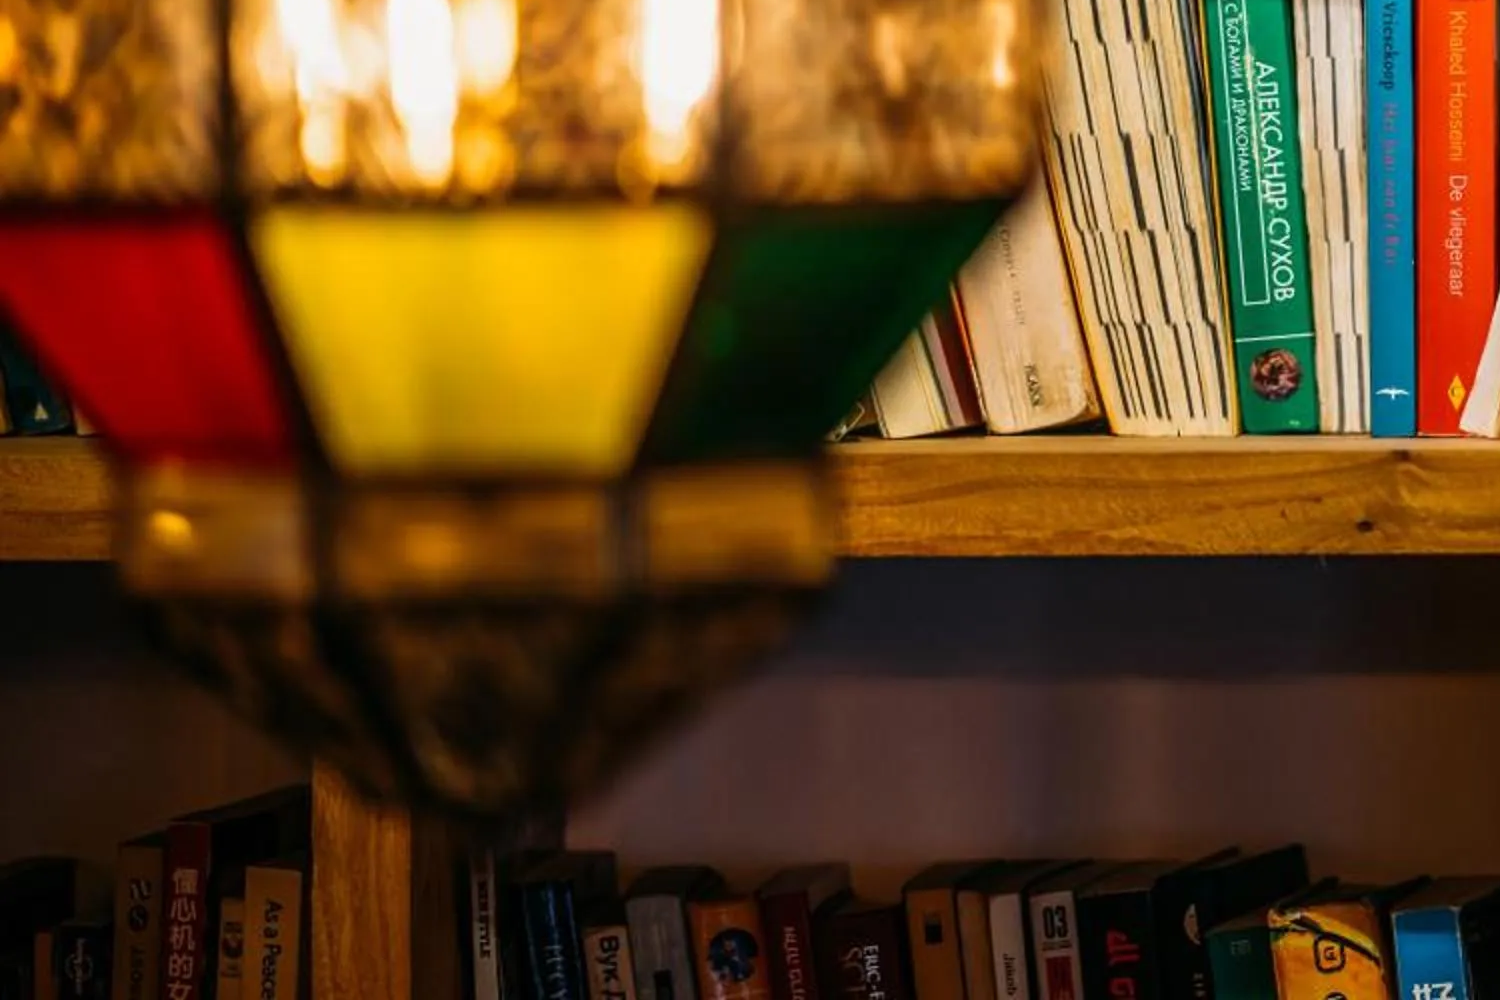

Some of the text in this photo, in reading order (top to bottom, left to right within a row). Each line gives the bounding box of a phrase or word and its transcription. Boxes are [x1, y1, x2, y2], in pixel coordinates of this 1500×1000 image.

[1224, 18, 1245, 78] БОГАМИ
[1378, 1, 1397, 90] Vriesekoop
[1231, 82, 1243, 94] И
[1231, 96, 1251, 191] ДРАКОНАМИ
[1443, 10, 1467, 297] Khaled Hosseini De vliegeraar
[1253, 59, 1296, 301] АЛЕКСАНДР СУХОВ
[264, 901, 282, 922] As
[264, 927, 277, 938] a
[1042, 904, 1068, 940] 03
